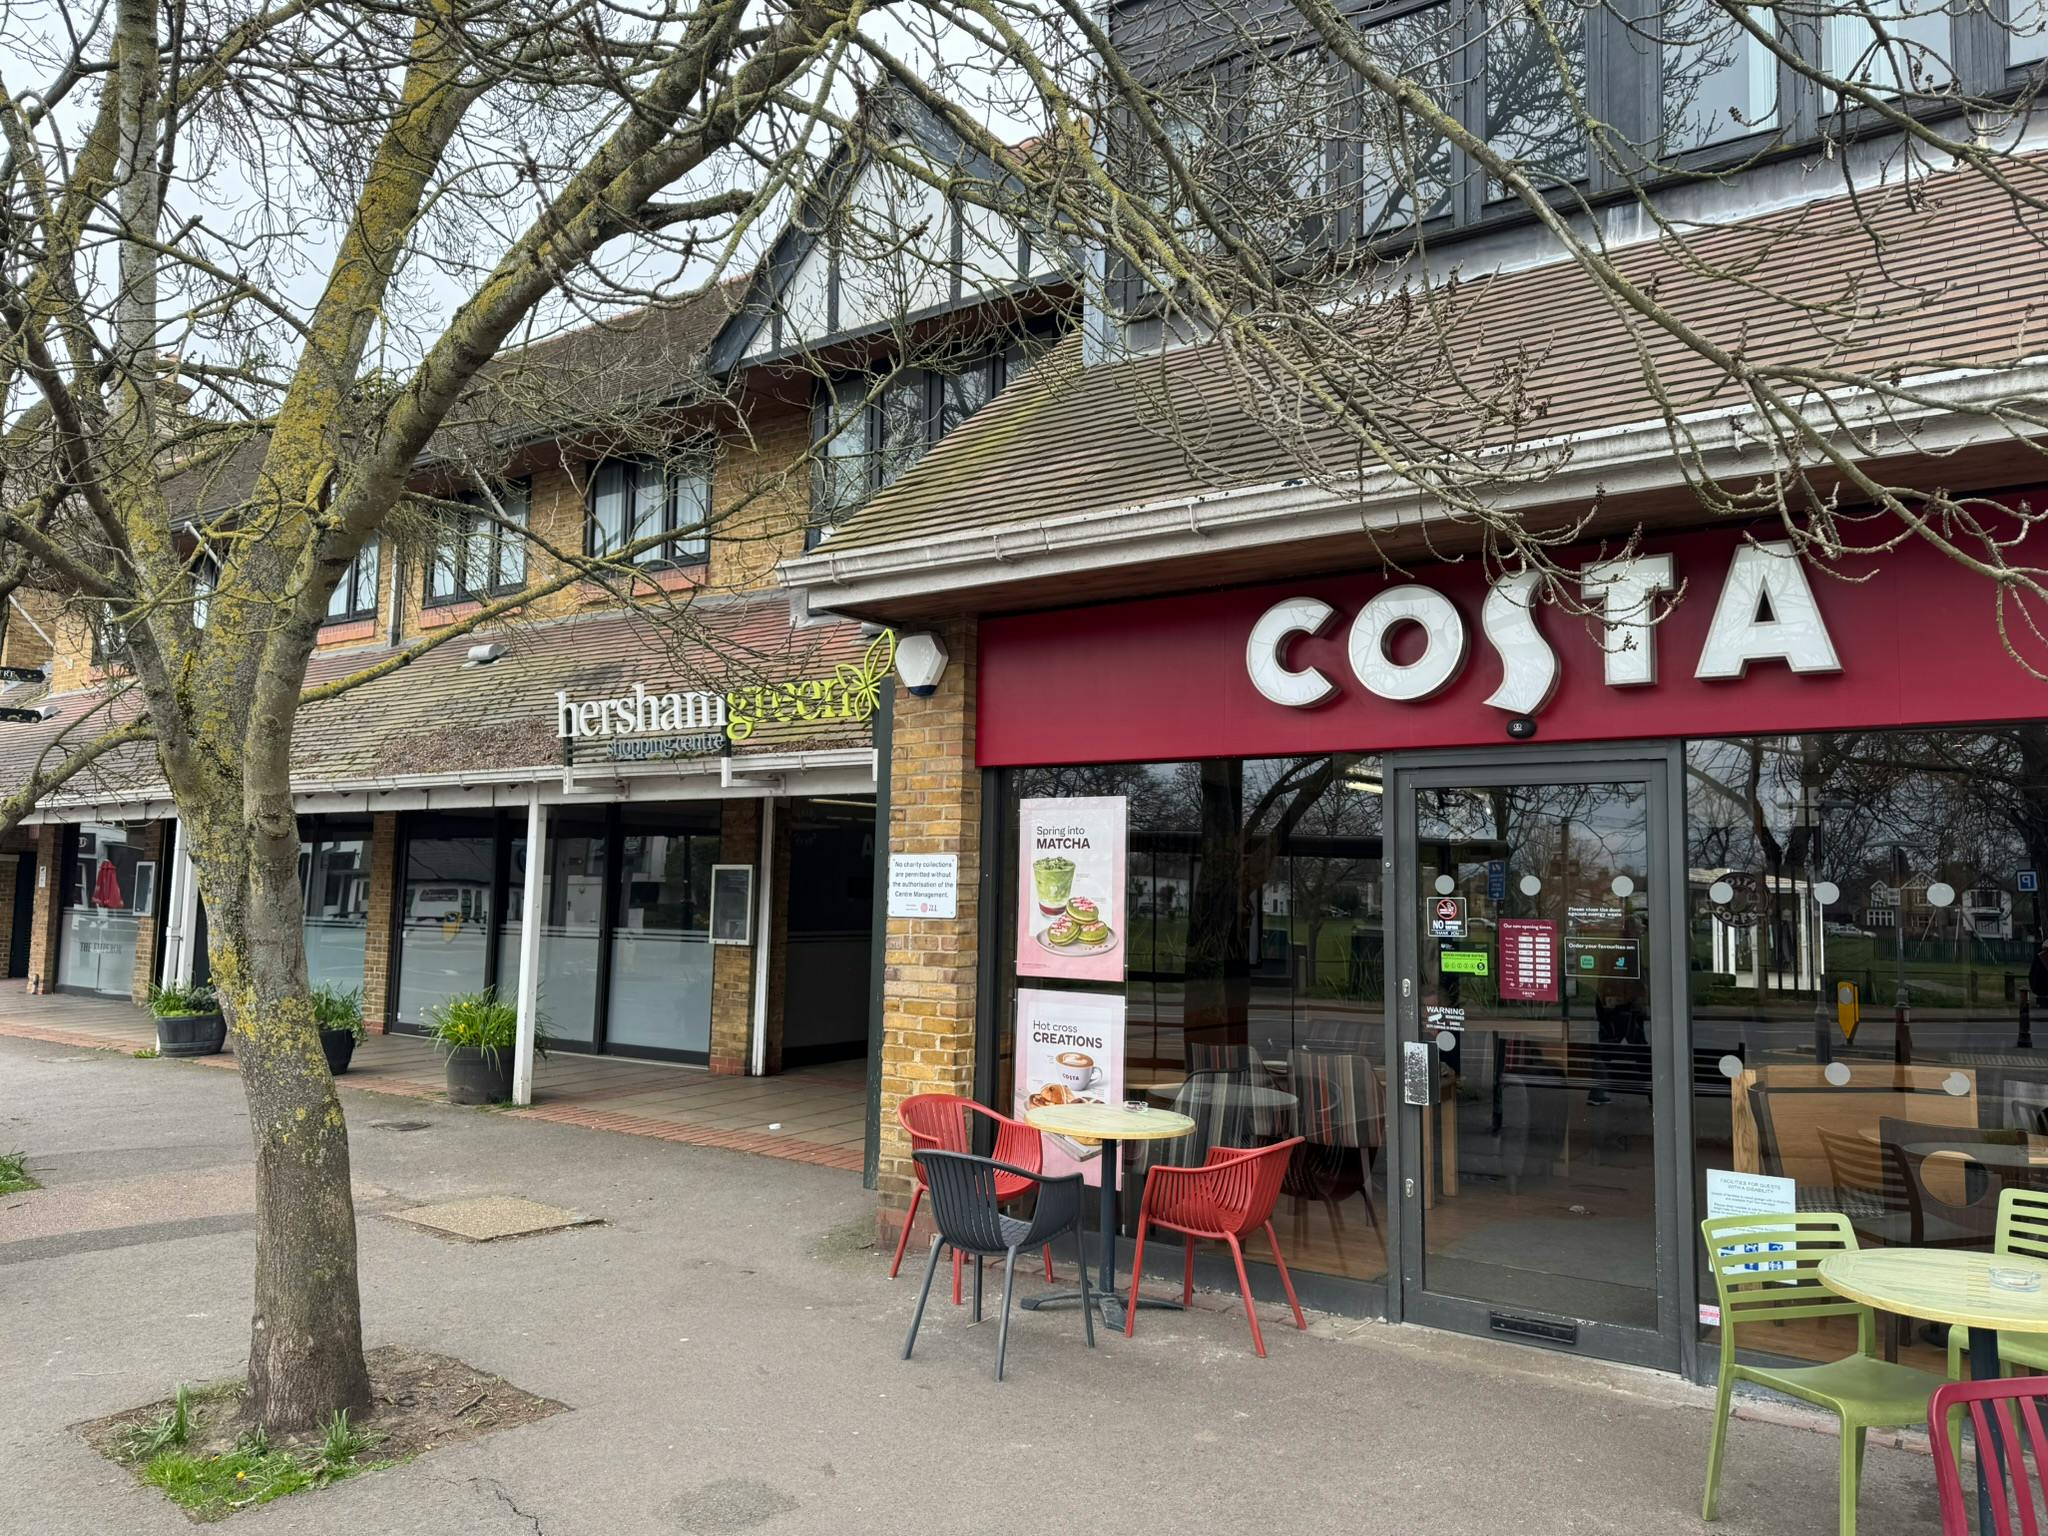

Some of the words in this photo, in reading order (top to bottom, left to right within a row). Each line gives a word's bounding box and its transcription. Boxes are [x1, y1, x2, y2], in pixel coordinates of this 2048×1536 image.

[1246, 540, 1845, 716] COSTA
[556, 684, 728, 738] hersham
[726, 678, 854, 740] green
[606, 735, 675, 760] shopping
[676, 732, 725, 752] centre
[1036, 826, 1065, 837] Spring
[1068, 826, 1085, 835] into
[1036, 838, 1090, 850] MATCHA
[1433, 920, 1444, 929] NO
[80, 942, 91, 952] THE
[1426, 1006, 1464, 1015] WARNING
[1033, 1020, 1050, 1031] Hot
[1053, 1025, 1078, 1033] cross
[1033, 1032, 1102, 1048] CREATIONS
[1062, 1073, 1079, 1081] COSTA
